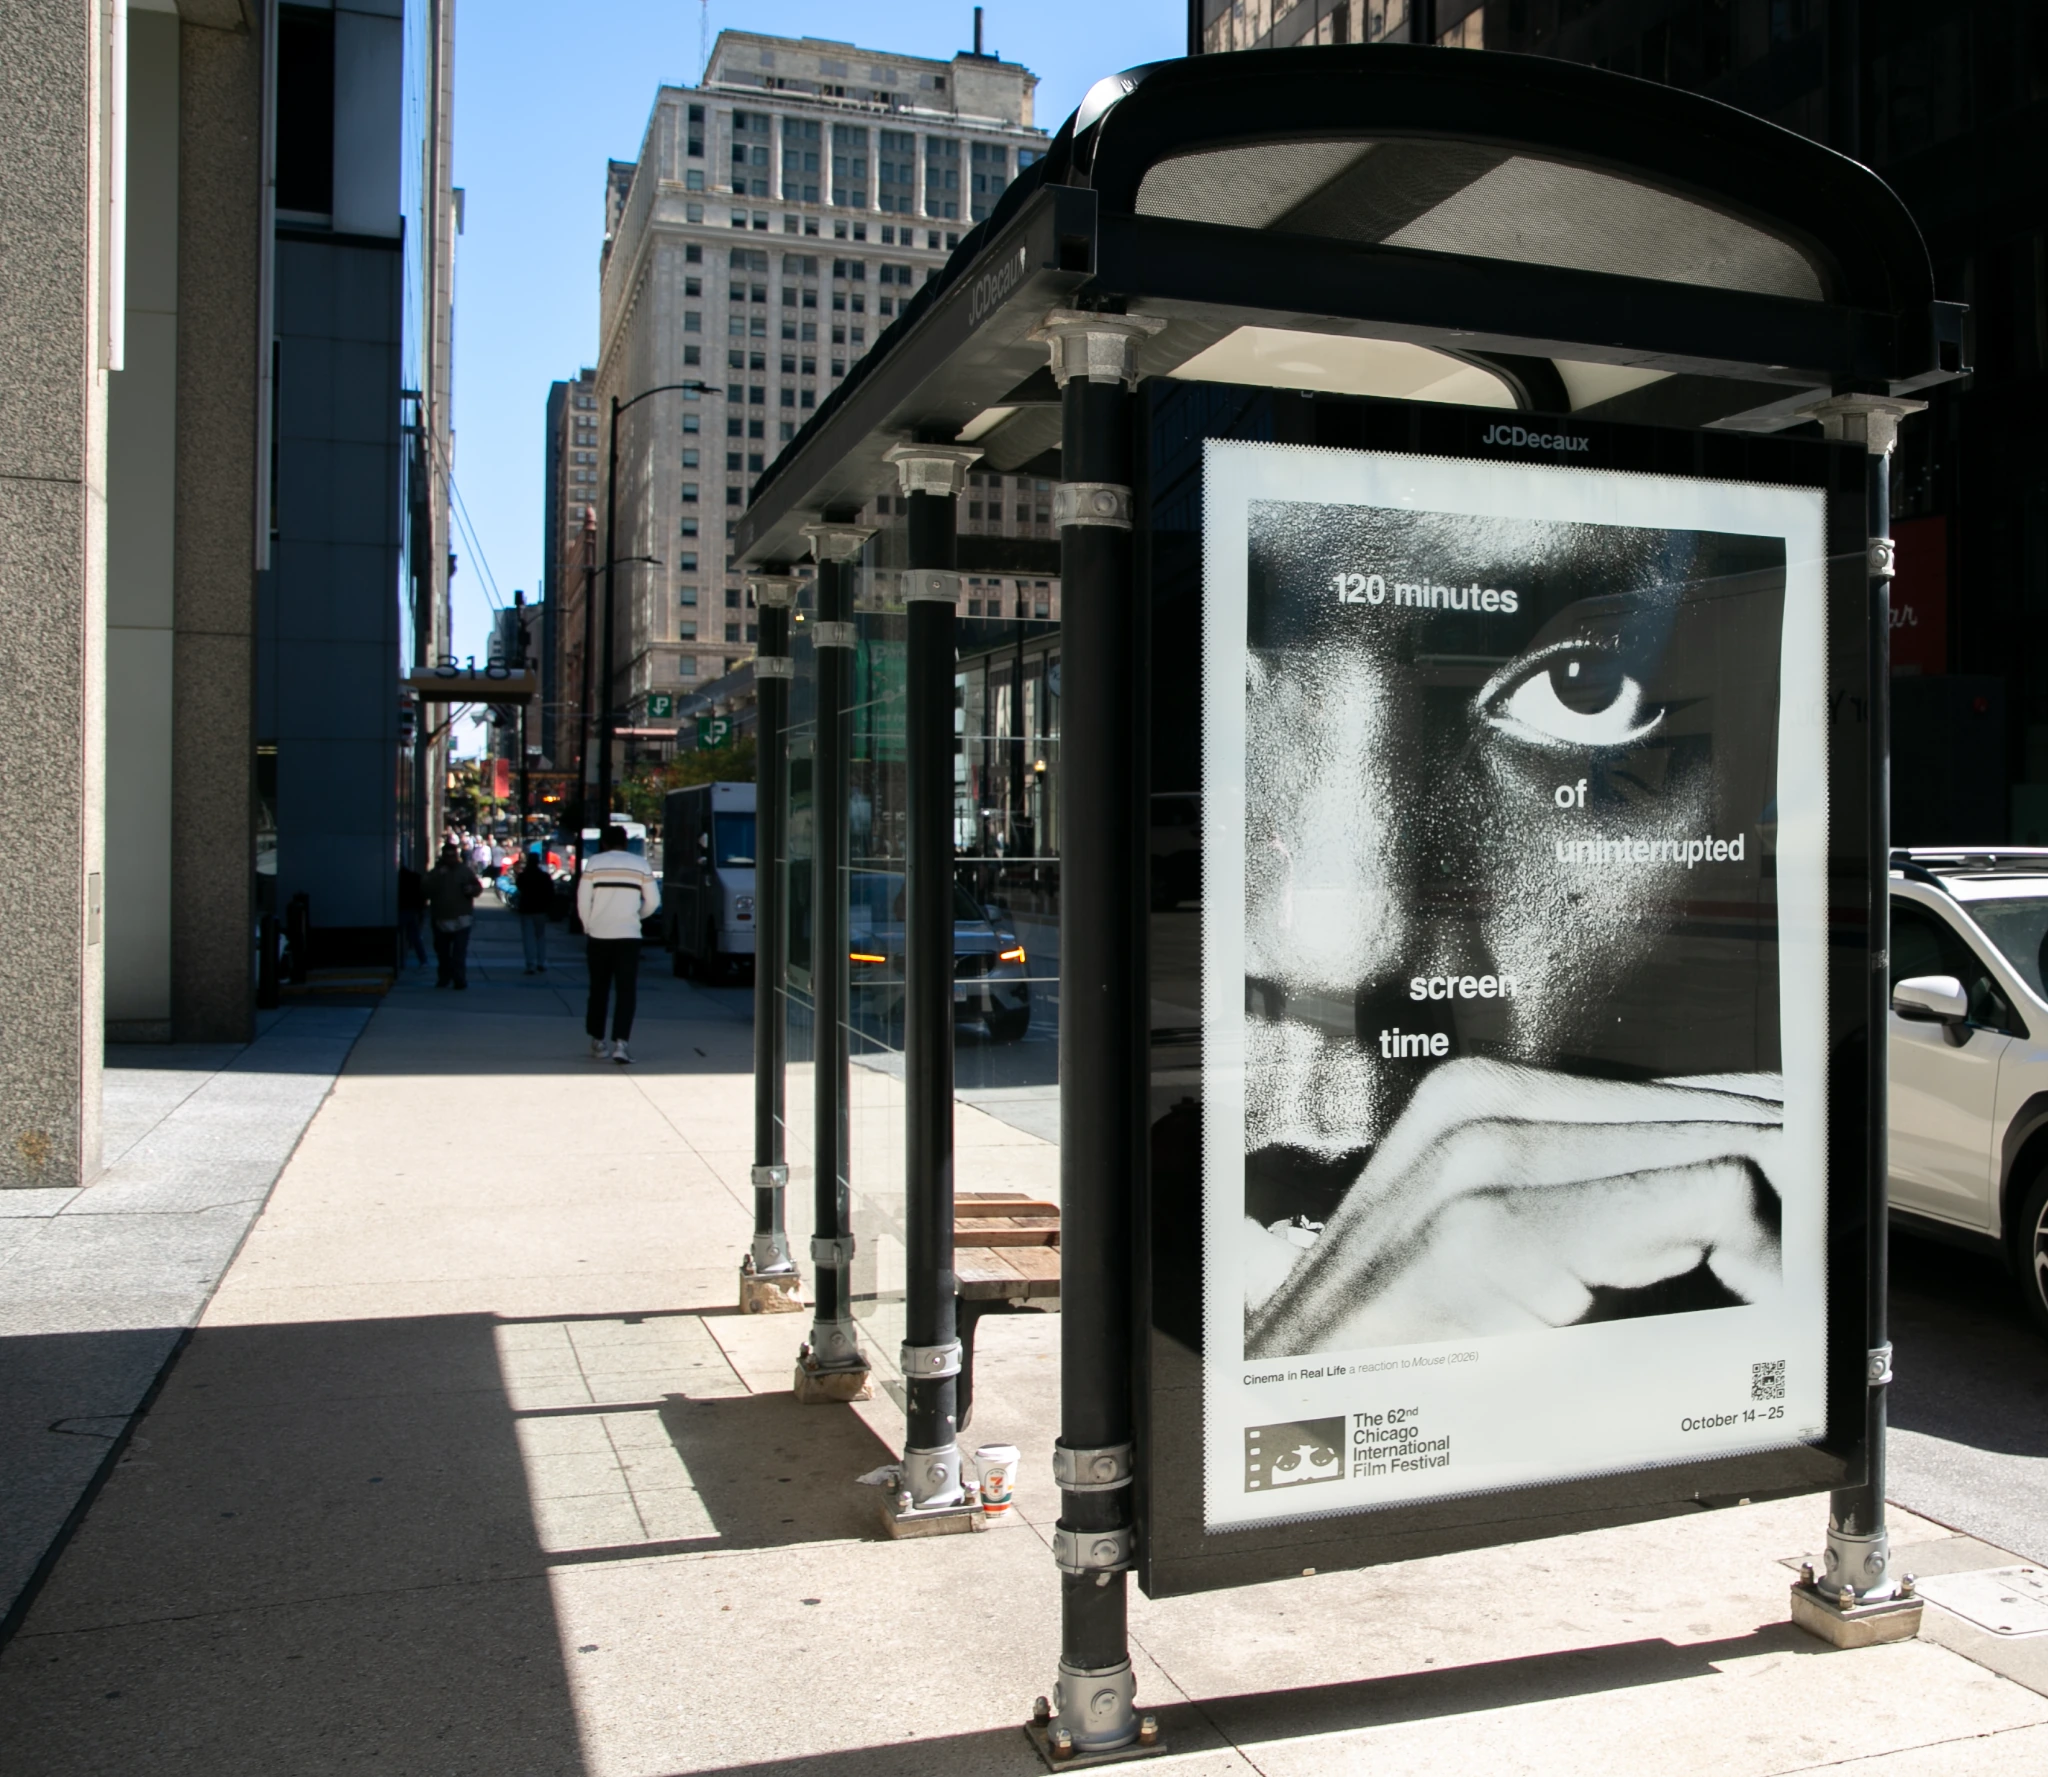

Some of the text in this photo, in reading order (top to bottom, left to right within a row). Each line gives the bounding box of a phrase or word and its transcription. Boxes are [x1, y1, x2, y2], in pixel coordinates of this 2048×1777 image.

[1482, 424, 1590, 452] JCDecaux
[1332, 572, 1519, 613] 120 minutes
[434, 655, 512, 681] 318
[1554, 778, 1588, 808] of
[1555, 833, 1745, 869] uninterrupted
[1409, 974, 1517, 1001] screen
[1379, 1027, 1449, 1059] time
[1243, 1351, 1479, 1386] Cinema in Real Life a reaction to Mouse (2026)
[1353, 1406, 1419, 1428] The 62nd
[1681, 1413, 1738, 1432] October
[1353, 1424, 1419, 1445] Chicago
[1353, 1435, 1450, 1462] International
[1353, 1452, 1450, 1478] Film Festival
